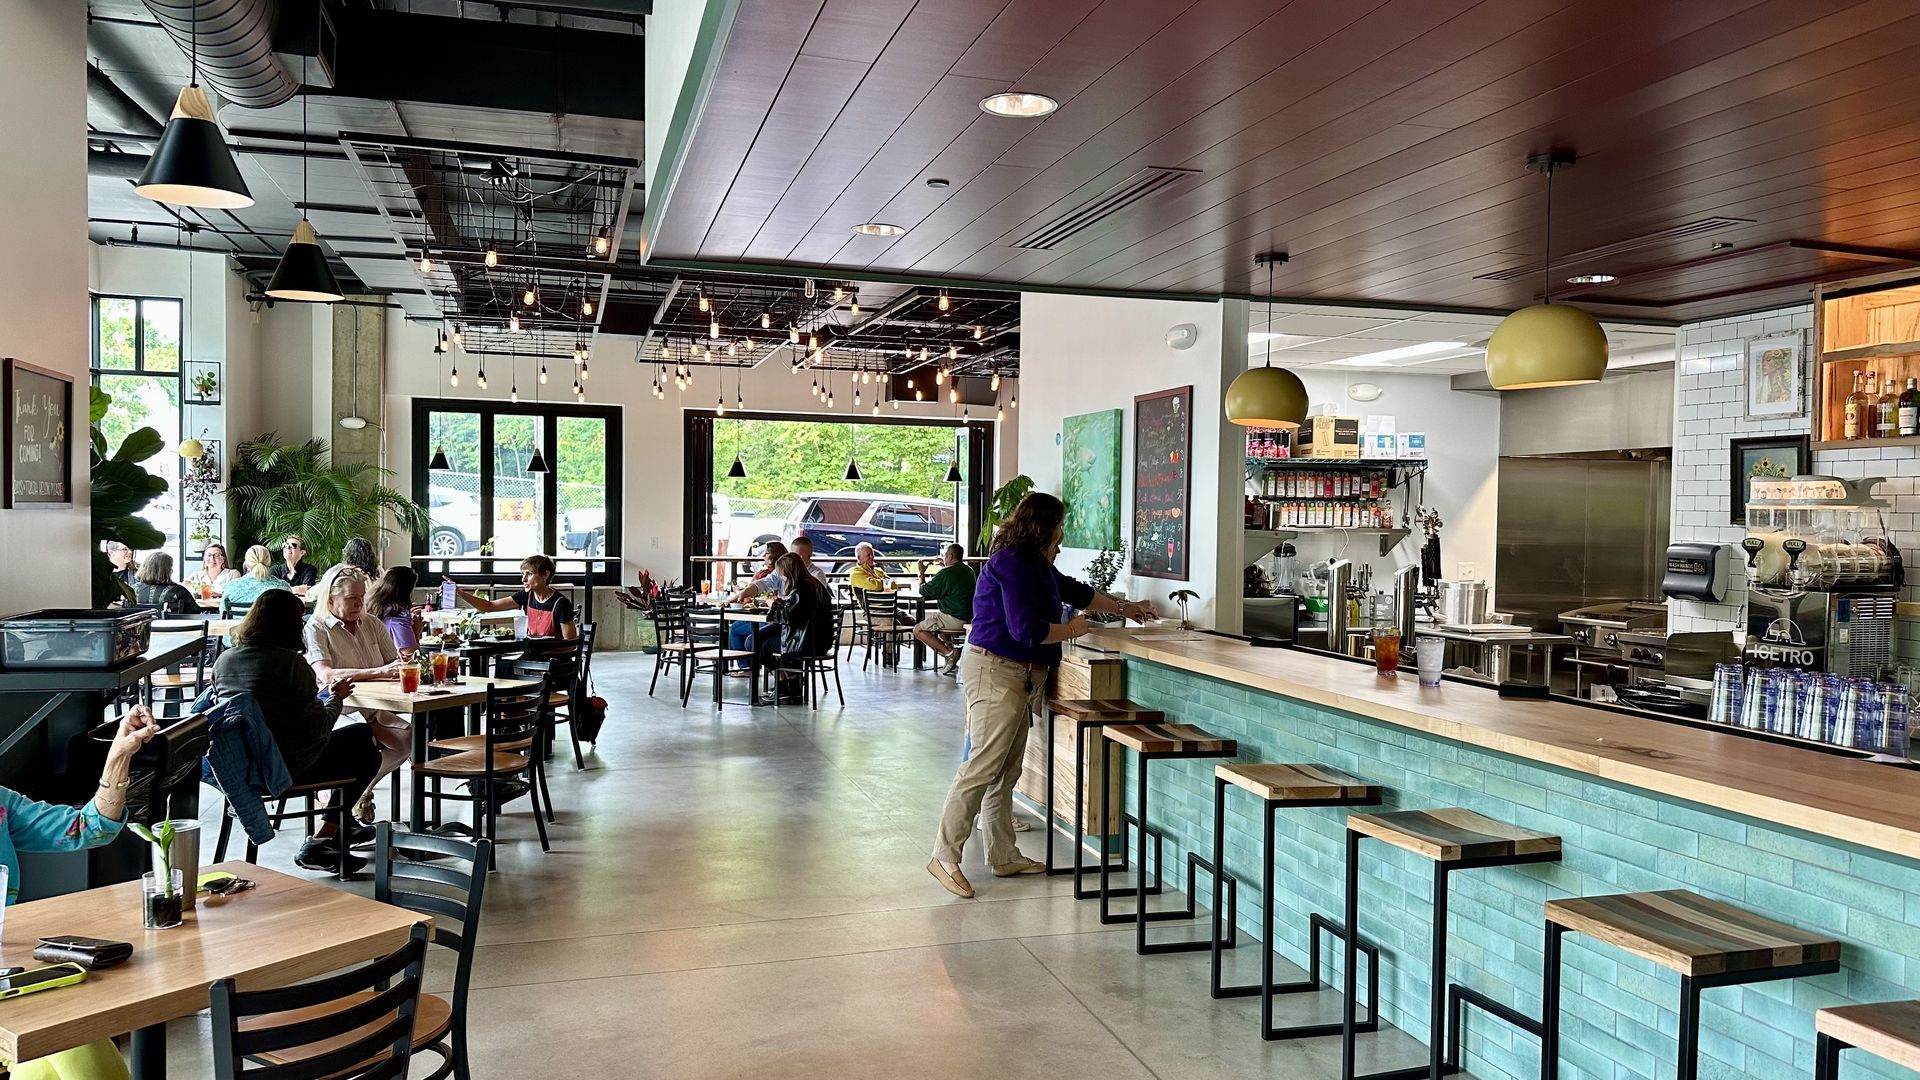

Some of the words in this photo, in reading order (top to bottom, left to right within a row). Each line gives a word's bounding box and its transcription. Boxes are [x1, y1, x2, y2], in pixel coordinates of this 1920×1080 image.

[15, 389, 39, 424] Thank
[42, 394, 62, 439] You
[23, 424, 35, 442] FOR
[19, 444, 42, 464] COMING!
[1753, 643, 1814, 666] ICETRO
